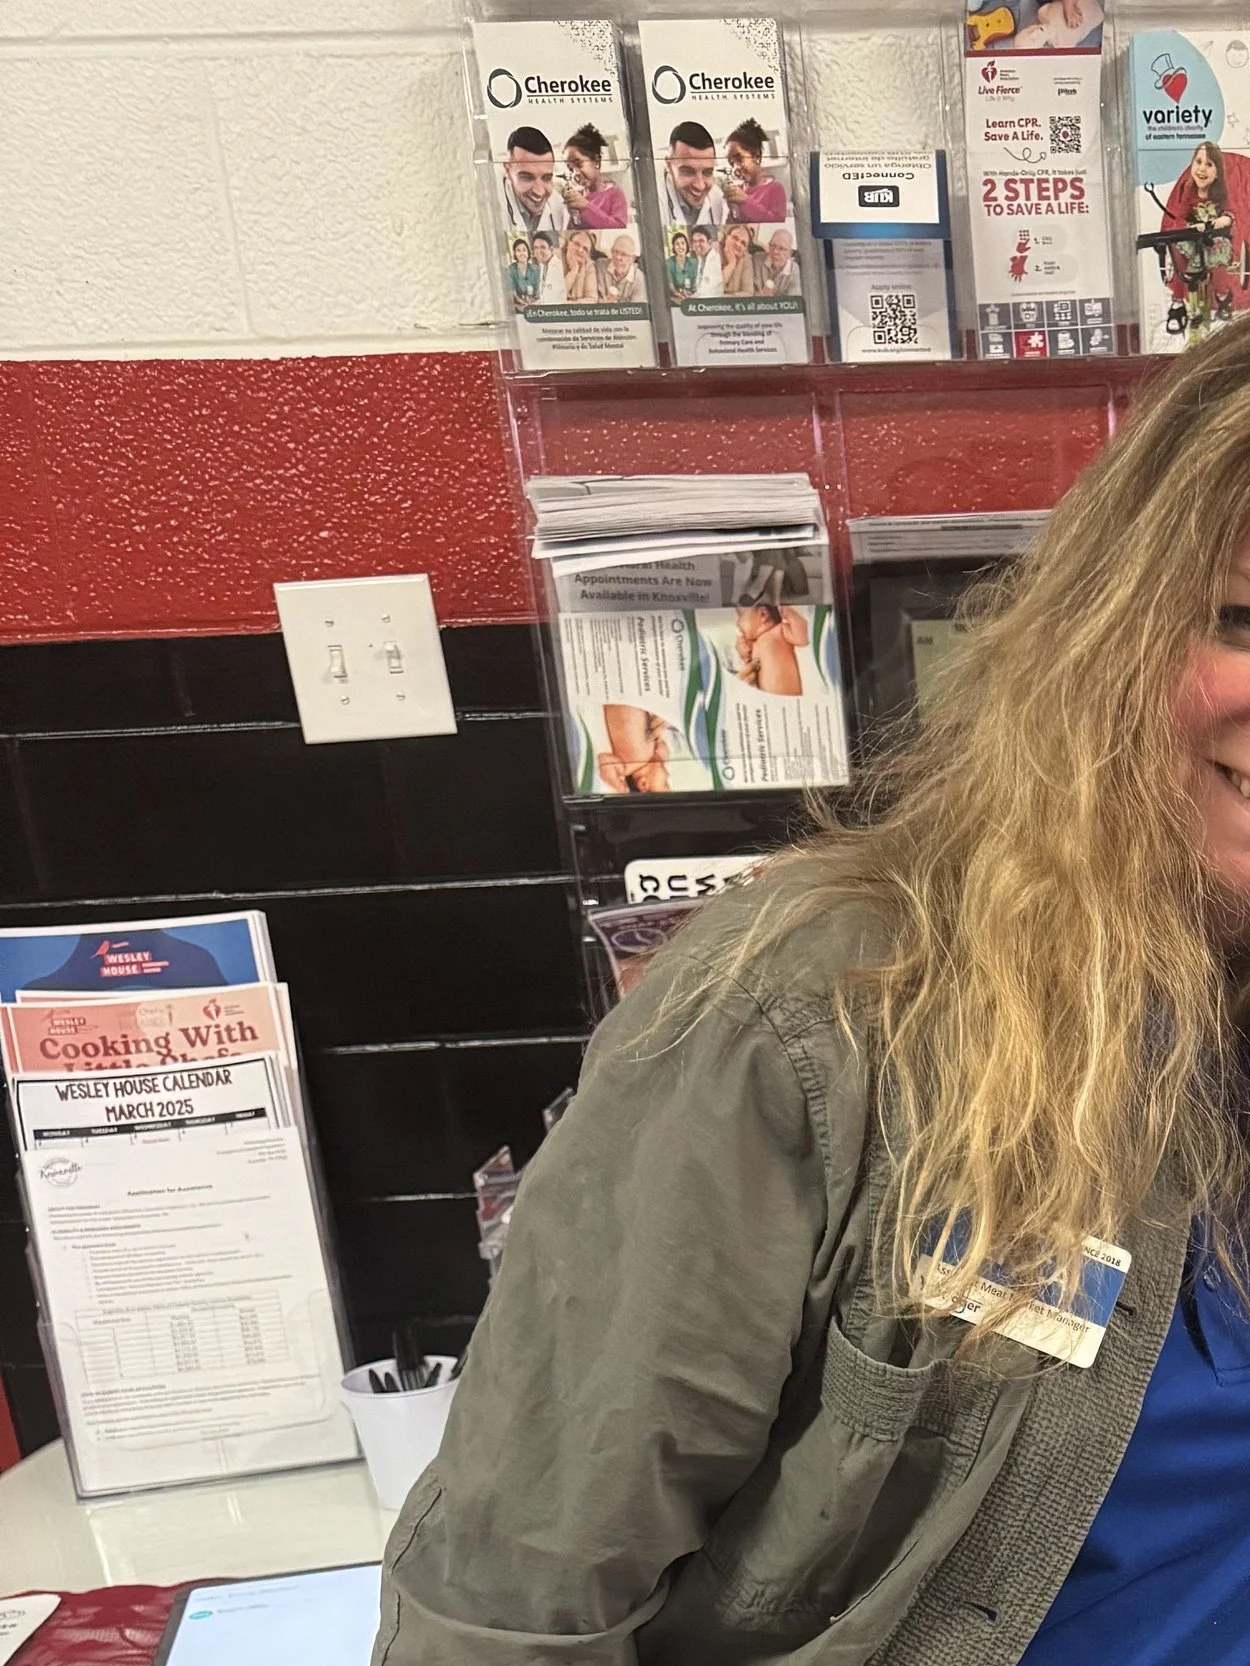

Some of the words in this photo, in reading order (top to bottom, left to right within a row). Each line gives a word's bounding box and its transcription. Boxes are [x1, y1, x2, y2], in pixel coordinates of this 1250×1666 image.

[524, 74, 612, 94] Cherokee
[689, 72, 775, 90] Cherokee
[528, 97, 564, 105] HEALTH
[570, 95, 613, 104] SYSTEMS
[692, 93, 727, 101] HEALTH
[733, 92, 776, 100] SYSTEMS
[986, 118, 1015, 129] Learn
[1017, 117, 1042, 128] CPR.
[1143, 105, 1212, 128] variety
[984, 131, 1009, 141] Save
[1011, 131, 1019, 140] A
[1020, 129, 1043, 141] Life.
[842, 172, 915, 180] ConnectED
[864, 189, 894, 204] KUB
[982, 178, 998, 202] 2
[1004, 176, 1086, 202] STEPS
[984, 203, 1004, 216] TO
[1007, 202, 1042, 216] SAVE
[1045, 202, 1056, 215] A
[1058, 201, 1090, 215] LIFE:
[574, 573, 659, 587] Appointments
[662, 576, 682, 586] Are
[685, 577, 712, 588] Now
[580, 589, 635, 602] Available
[638, 591, 650, 602] in
[652, 590, 710, 604] Knoxville!
[641, 657, 651, 692] Services
[106, 951, 151, 964] WESLEY
[102, 965, 138, 976] HOUSE
[40, 1033, 171, 1060] Cooking
[179, 1020, 259, 1049] With
[56, 1080, 110, 1101] WESLEY
[114, 1078, 160, 1099] HOUSE
[163, 1068, 233, 1093] CALENDAR
[105, 1103, 154, 1123] MARCH
[158, 1099, 194, 1118] 2025
[1101, 1252, 1121, 1268] 2018
[981, 1282, 1007, 1299] Meat
